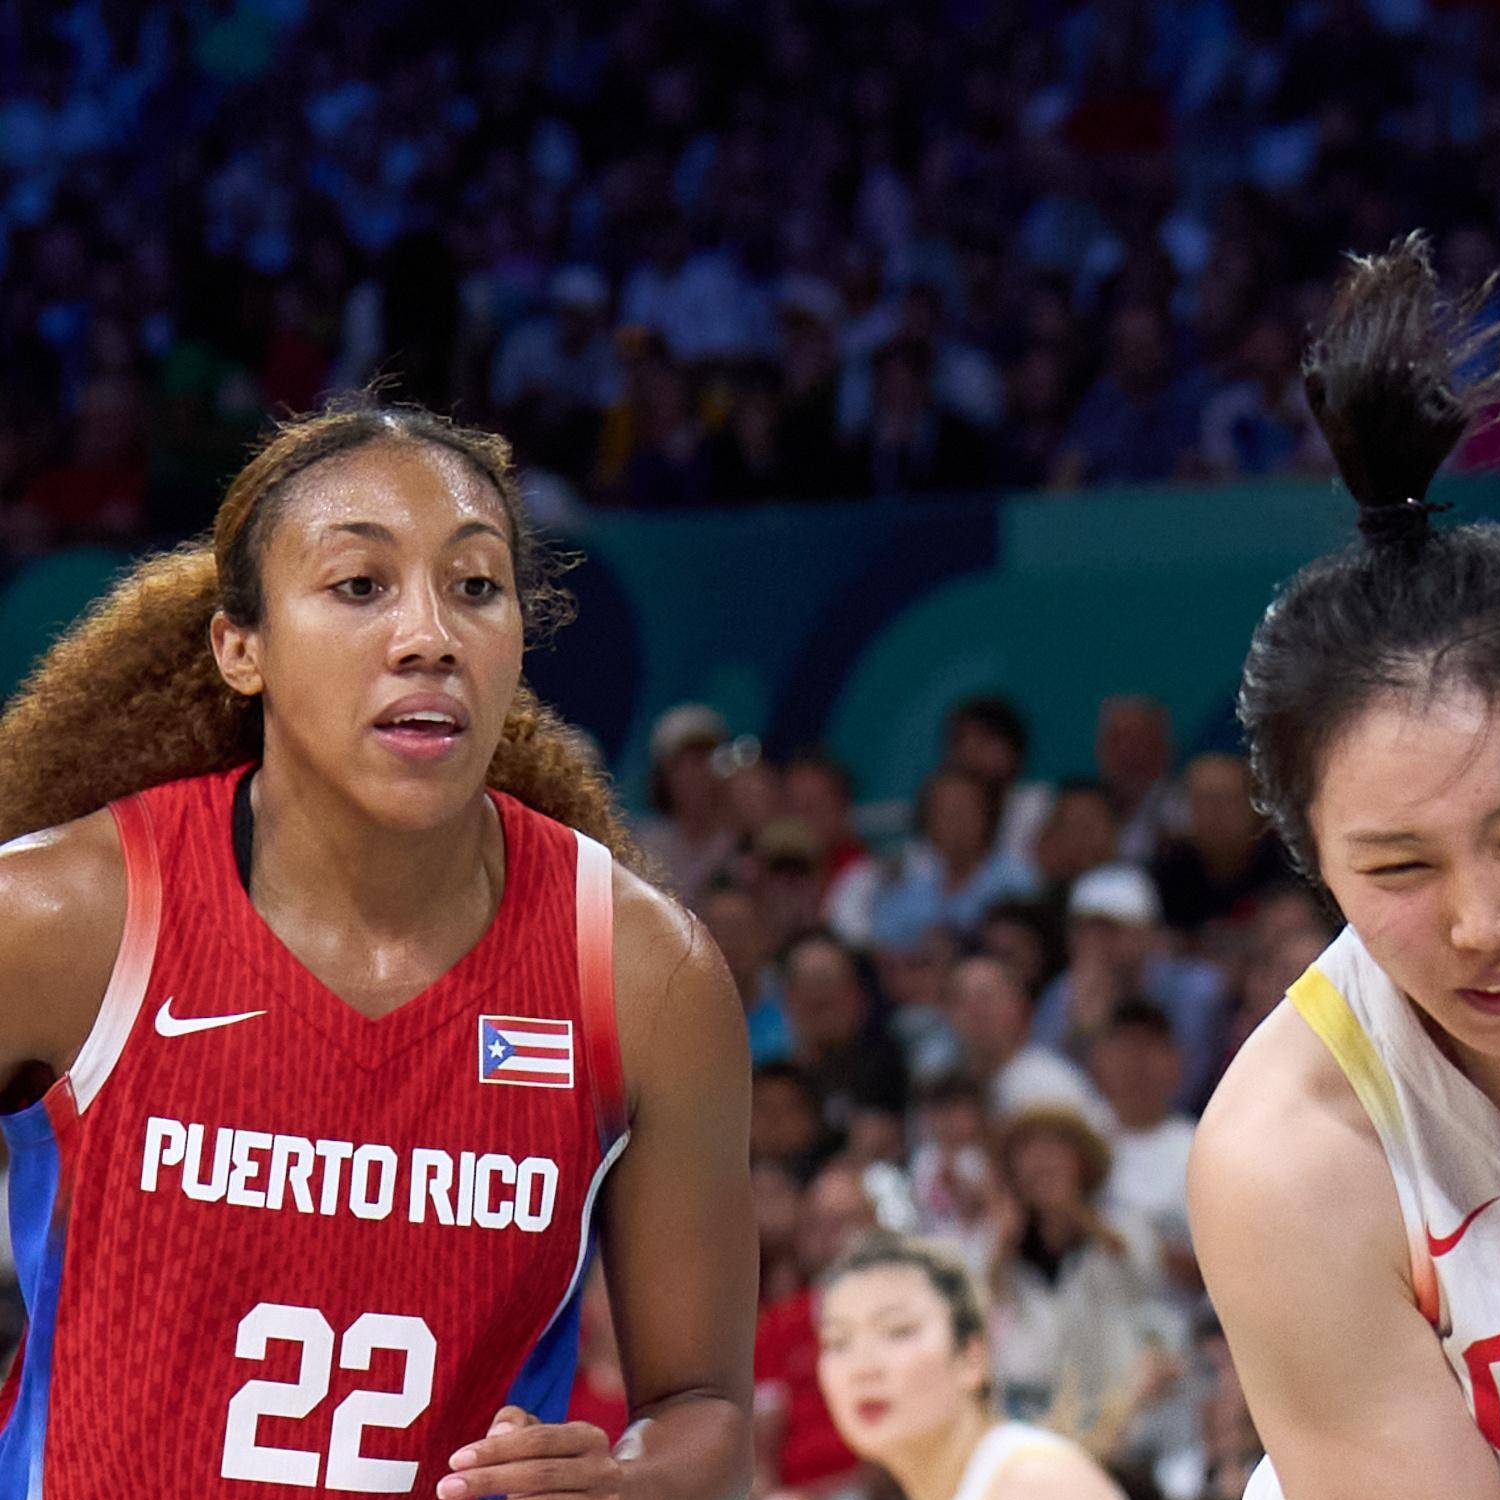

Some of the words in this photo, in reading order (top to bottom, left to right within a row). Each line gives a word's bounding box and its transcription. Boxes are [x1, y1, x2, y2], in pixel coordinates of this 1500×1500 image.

[141, 1116, 397, 1221] PUERTO
[409, 1147, 560, 1233] RICO
[221, 1302, 438, 1494] 22
